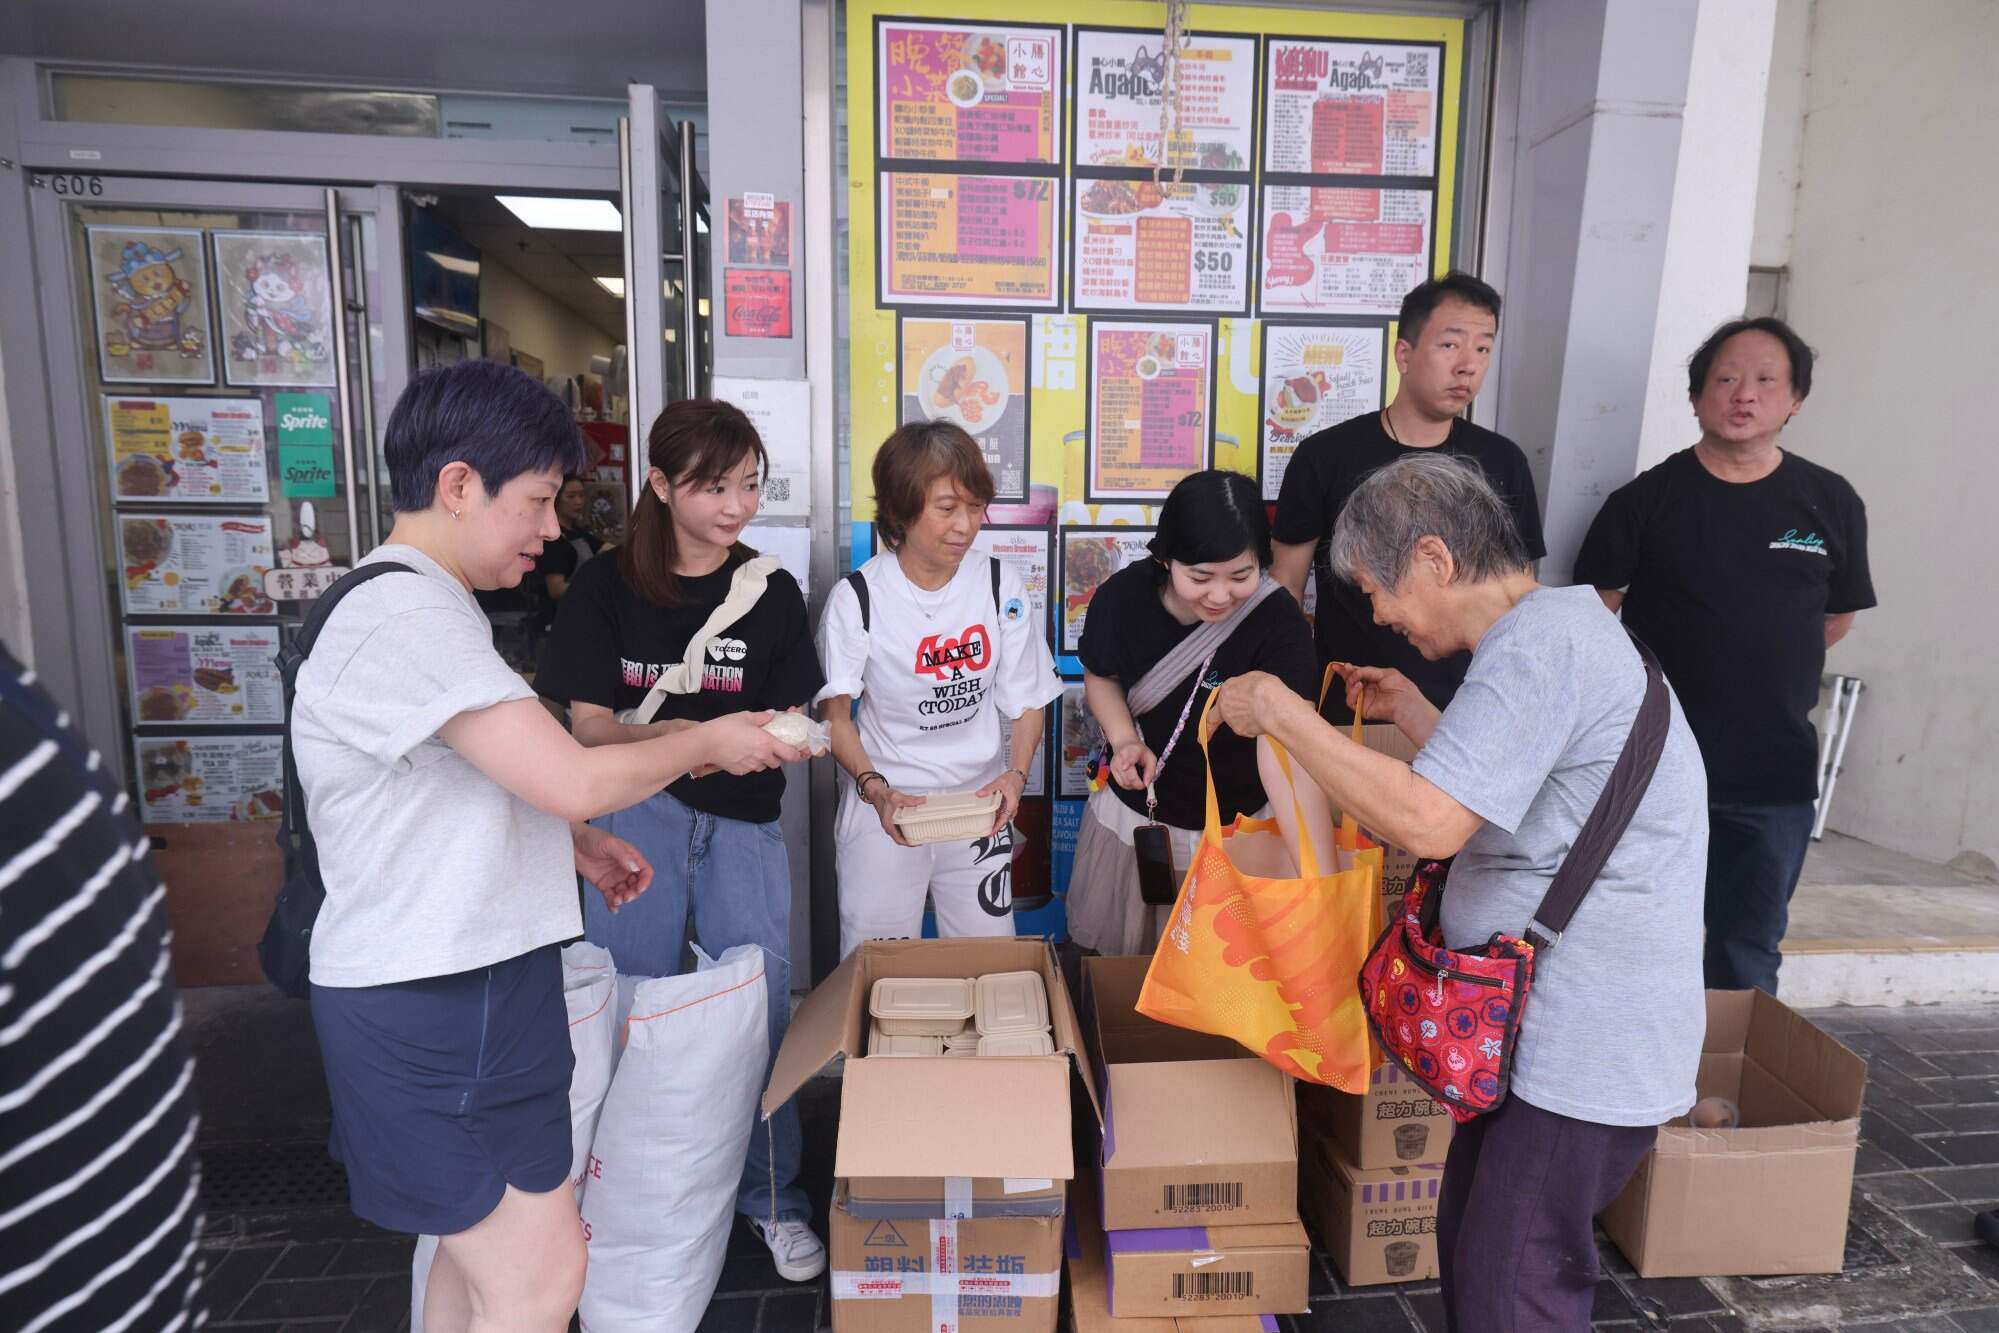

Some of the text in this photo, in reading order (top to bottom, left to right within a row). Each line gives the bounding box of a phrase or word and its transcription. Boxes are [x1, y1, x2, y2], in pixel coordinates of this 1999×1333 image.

[52, 175, 104, 196] G06
[1209, 190, 1237, 207] $50
[1194, 249, 1233, 273] $50
[280, 413, 328, 431] Sprite
[285, 466, 331, 484] Sprite
[922, 640, 982, 667] MAKE
[950, 666, 965, 682] A
[932, 677, 983, 699] WISH
